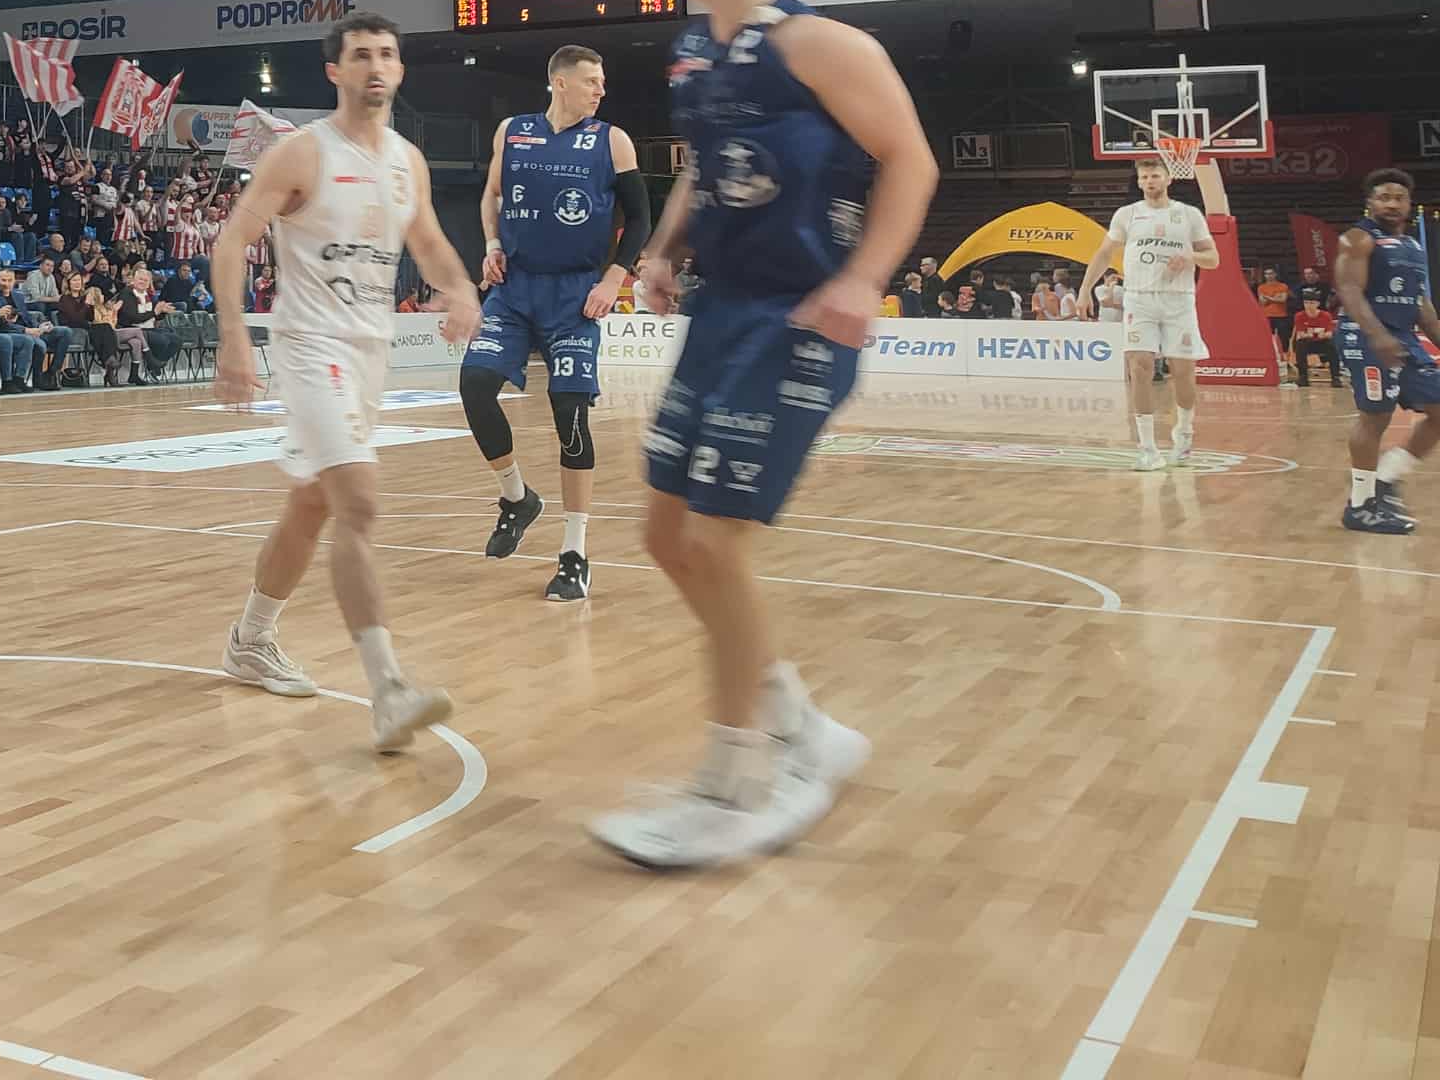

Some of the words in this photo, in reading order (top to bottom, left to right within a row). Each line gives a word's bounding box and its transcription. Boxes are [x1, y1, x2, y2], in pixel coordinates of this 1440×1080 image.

[520, 8, 529, 22] 5
[597, 3, 606, 15] 4
[572, 133, 597, 150] 13
[607, 321, 675, 338] LARE
[601, 344, 665, 358] ERGY
[862, 335, 957, 357] PTeam
[978, 337, 1113, 361] HEATING
[553, 356, 574, 377] 13
